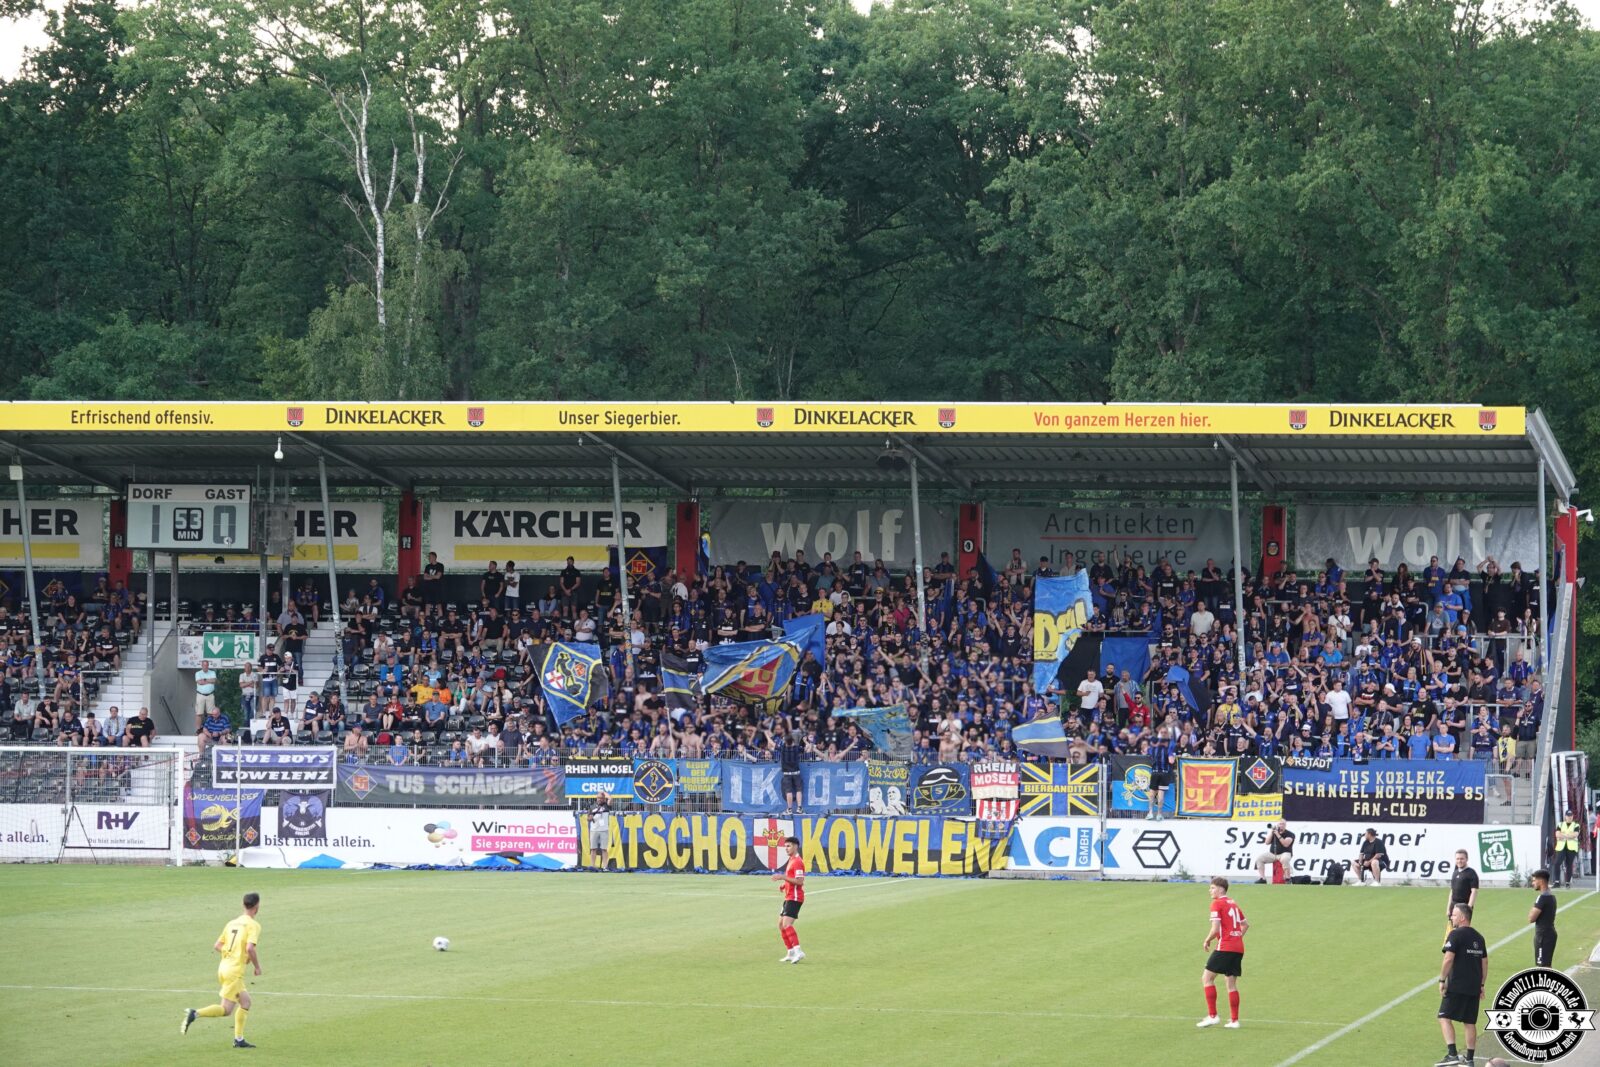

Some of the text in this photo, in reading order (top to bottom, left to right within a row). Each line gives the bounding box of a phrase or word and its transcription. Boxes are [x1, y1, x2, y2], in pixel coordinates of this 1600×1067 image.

[71, 410, 214, 424] Erfrischend offensiv.
[325, 407, 446, 427] DINKELACKER
[558, 410, 681, 428] Unser Siegerbier.
[793, 407, 917, 428] DINKELACKER
[1034, 412, 1212, 429] Von ganzem Herzen hier.
[1329, 409, 1456, 430] DINKELACKER
[132, 488, 173, 499] DORF
[204, 488, 246, 500] GAST
[151, 504, 160, 543] 1
[174, 508, 203, 530] 53
[213, 505, 237, 544] 0
[454, 510, 642, 538] KÄRCHER
[1044, 513, 1195, 534] Architekten
[177, 530, 199, 540] MIN
[760, 509, 904, 562] wolf
[1347, 512, 1494, 565] wolf
[220, 753, 330, 764] BLUE BOYS
[973, 762, 1017, 773] RHEIN
[220, 770, 329, 780] KOWELENZ
[565, 764, 633, 774] RHEIN MOSEL
[1339, 770, 1445, 785] TUS KOBLENZ
[386, 773, 537, 795] TUS SCHÄNGEL
[581, 782, 615, 793] CREW
[808, 767, 863, 806] 03
[974, 773, 1015, 785] MOSEL
[1024, 784, 1095, 793] BIERBANDITEN
[1284, 781, 1369, 799] SCHÄNGEL
[1375, 785, 1456, 800] HOTSPURS
[1353, 802, 1428, 817] FAN-CLUB
[97, 811, 140, 830] R+V
[264, 835, 290, 847] bist
[332, 835, 376, 848] allein.
[476, 839, 577, 851] Sie sparen, wir dru
[1078, 828, 1090, 865] GMBH
[231, 929, 239, 953] 7
